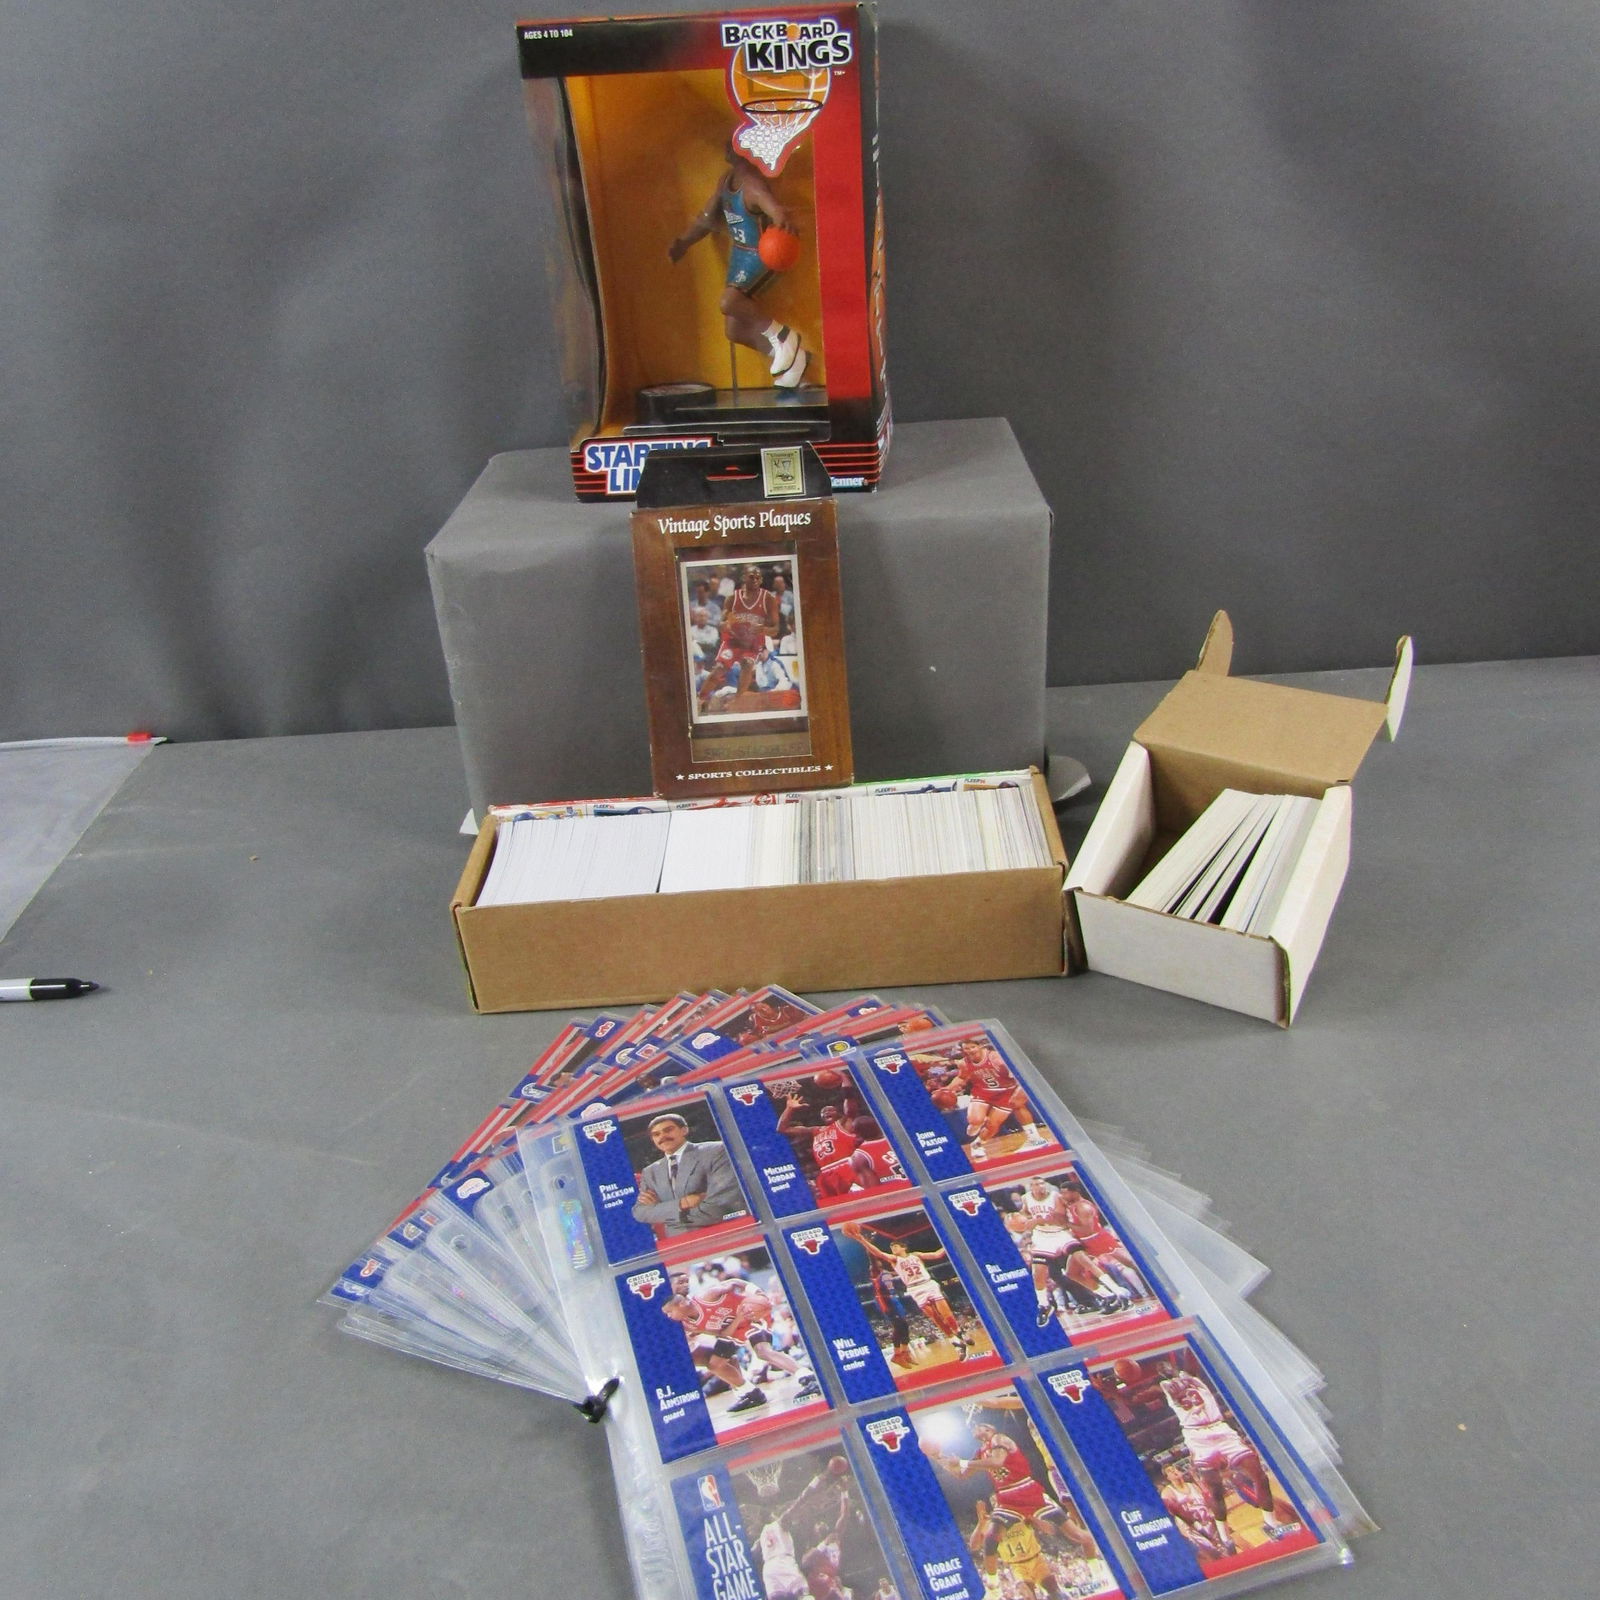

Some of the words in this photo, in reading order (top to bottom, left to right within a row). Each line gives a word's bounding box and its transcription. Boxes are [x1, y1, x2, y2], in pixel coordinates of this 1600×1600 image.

[523, 30, 542, 40] AGES
[543, 30, 549, 39] 4
[549, 29, 559, 38] TO
[560, 28, 574, 38] 104
[722, 18, 837, 46] BACKBOARD
[748, 34, 851, 71] KINGS
[586, 440, 709, 471] STAR
[657, 516, 710, 539] Vintage
[713, 514, 756, 538] Sports
[759, 508, 812, 533] Plaques
[687, 770, 733, 780] SPORTS
[735, 764, 822, 777] COLLECTIBLES
[915, 1131, 936, 1141] JOHN
[918, 1136, 949, 1148] PAXSON
[762, 1163, 797, 1177] MICHAEL
[767, 1172, 797, 1184] JORDAN
[599, 1183, 619, 1193] PHIL
[602, 1186, 635, 1201] JACKSON
[604, 1198, 624, 1209] coach
[832, 1337, 857, 1350] WILL
[837, 1345, 871, 1361] PERDUE
[843, 1360, 866, 1371] center
[656, 1385, 676, 1399] B.J.
[660, 1390, 701, 1411] ARMSTRONG
[662, 1407, 686, 1424] guard
[1121, 1510, 1144, 1524] CLIFF
[704, 1512, 742, 1548] ALL-
[1006, 1541, 1025, 1557] 14
[1136, 1534, 1169, 1551] forward
[706, 1539, 750, 1579] STAR
[923, 1557, 963, 1578] HORACE
[713, 1567, 759, 1600] GAME
[930, 1572, 963, 1592] GRANT
